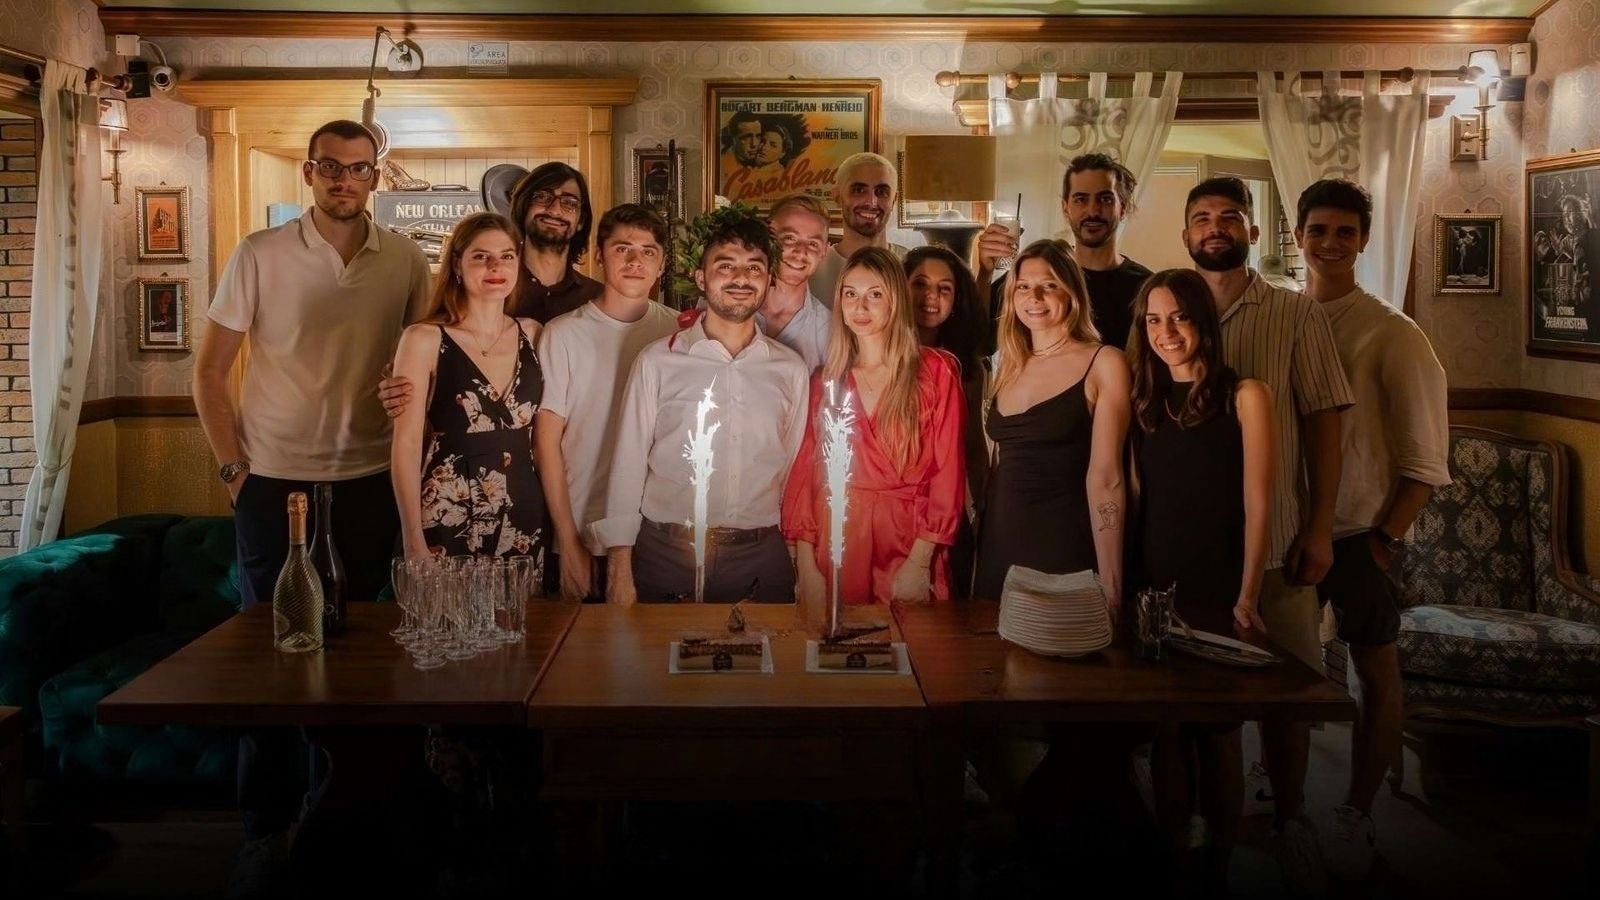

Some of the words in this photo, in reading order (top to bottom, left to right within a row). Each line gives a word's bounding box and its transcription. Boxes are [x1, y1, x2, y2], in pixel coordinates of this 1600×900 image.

[721, 102, 761, 112] BOGART
[766, 102, 816, 112] BERGMAN
[821, 102, 862, 112] HENREID
[811, 131, 839, 140] WARNER
[722, 157, 839, 203] Casablanc
[395, 204, 424, 218] NEW
[429, 204, 482, 218] ORLEAN
